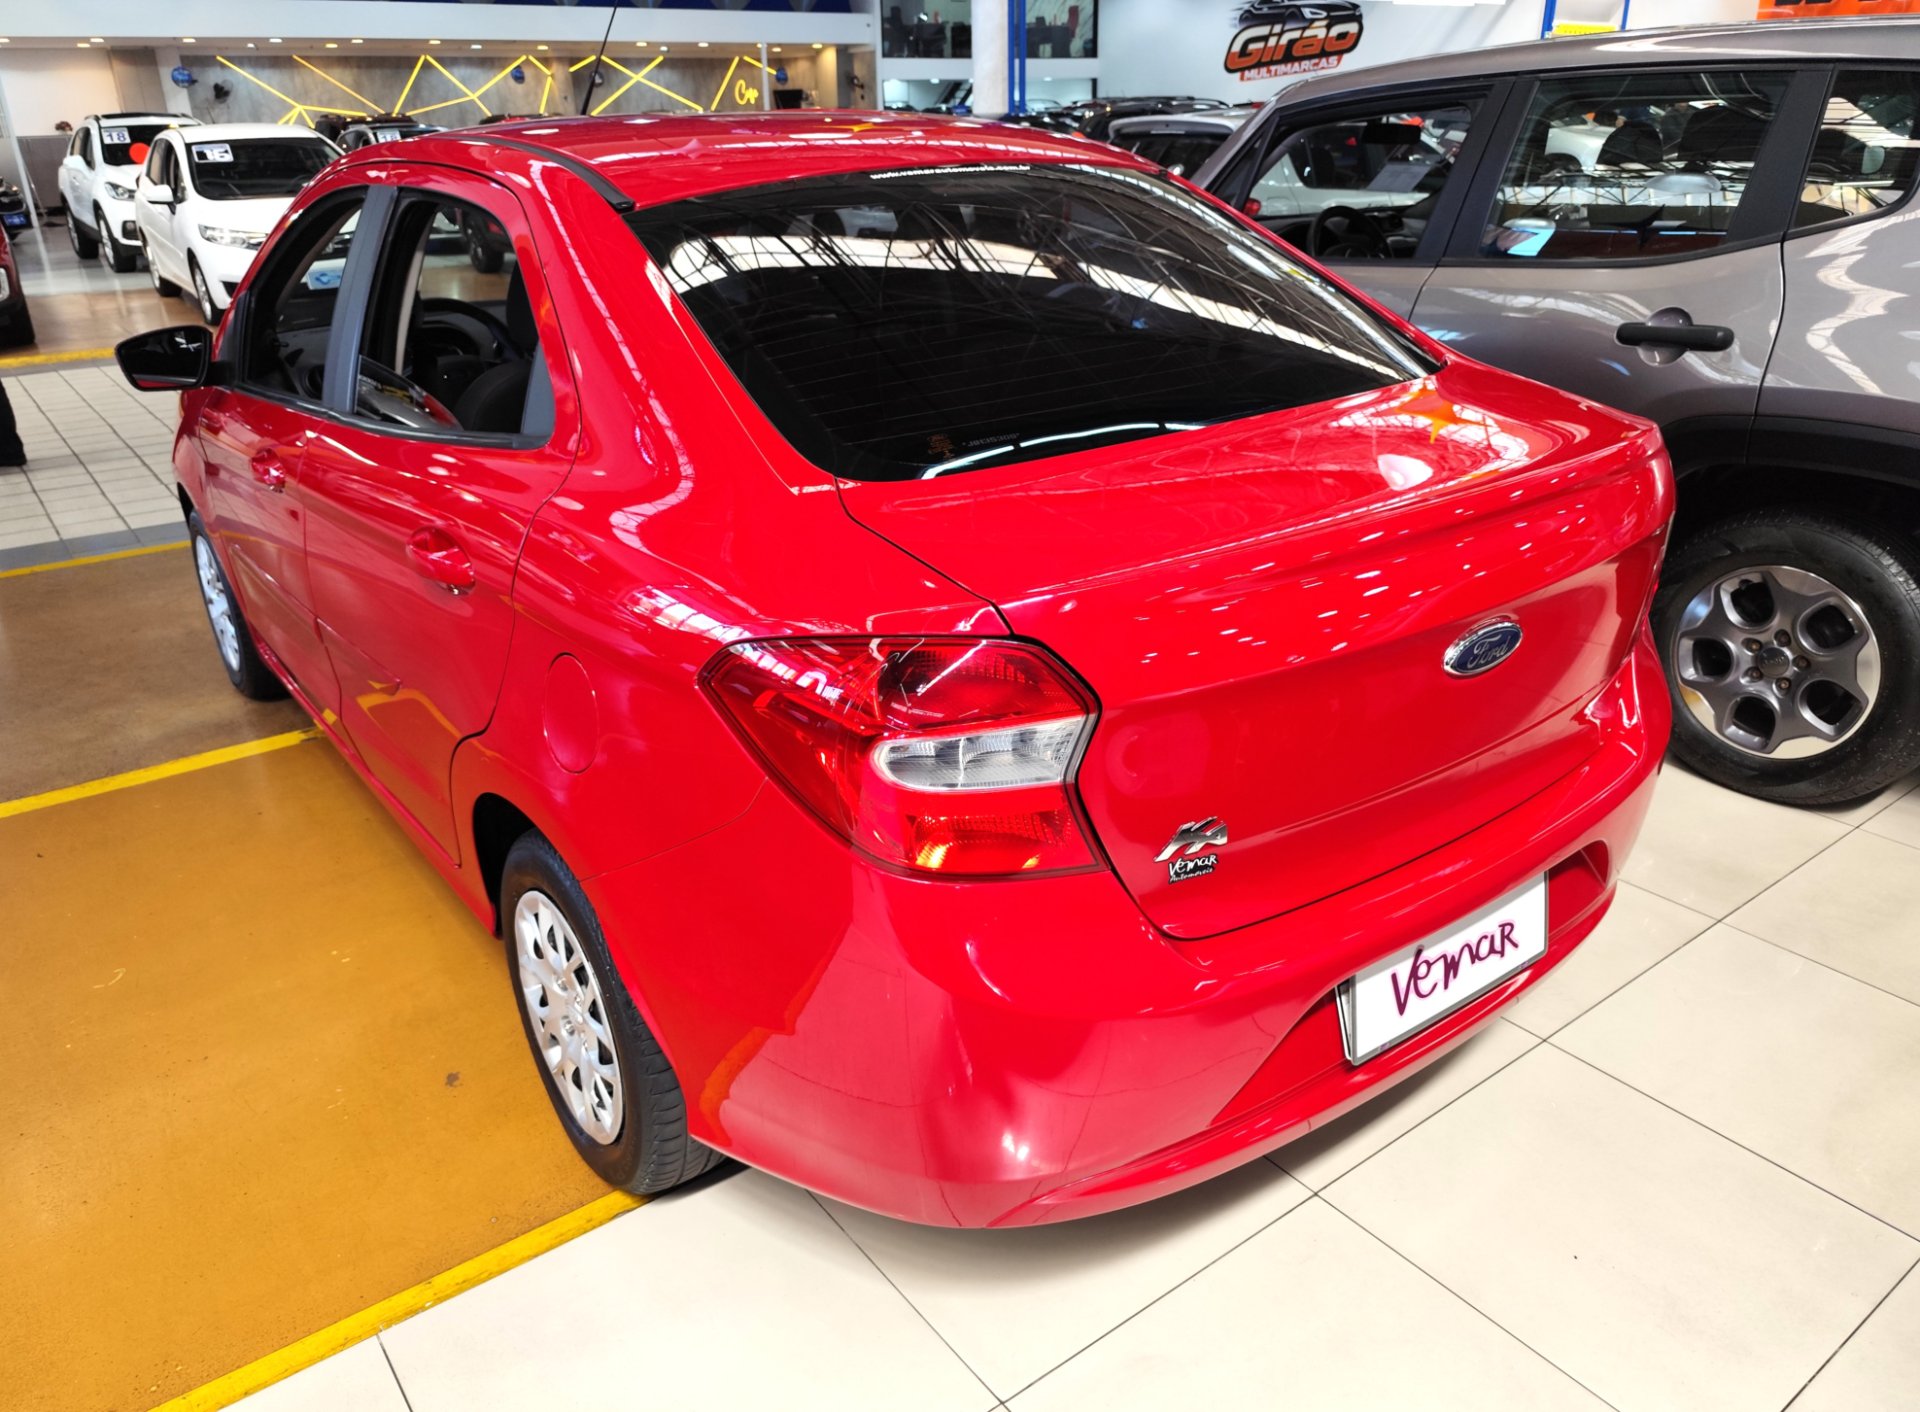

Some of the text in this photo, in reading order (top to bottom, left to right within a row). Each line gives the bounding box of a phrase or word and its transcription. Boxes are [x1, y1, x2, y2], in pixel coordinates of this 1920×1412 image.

[1226, 20, 1359, 70] Girão
[1243, 57, 1339, 81] MULTIMARCAS
[106, 131, 127, 142] 18
[1466, 634, 1512, 669] Ford
